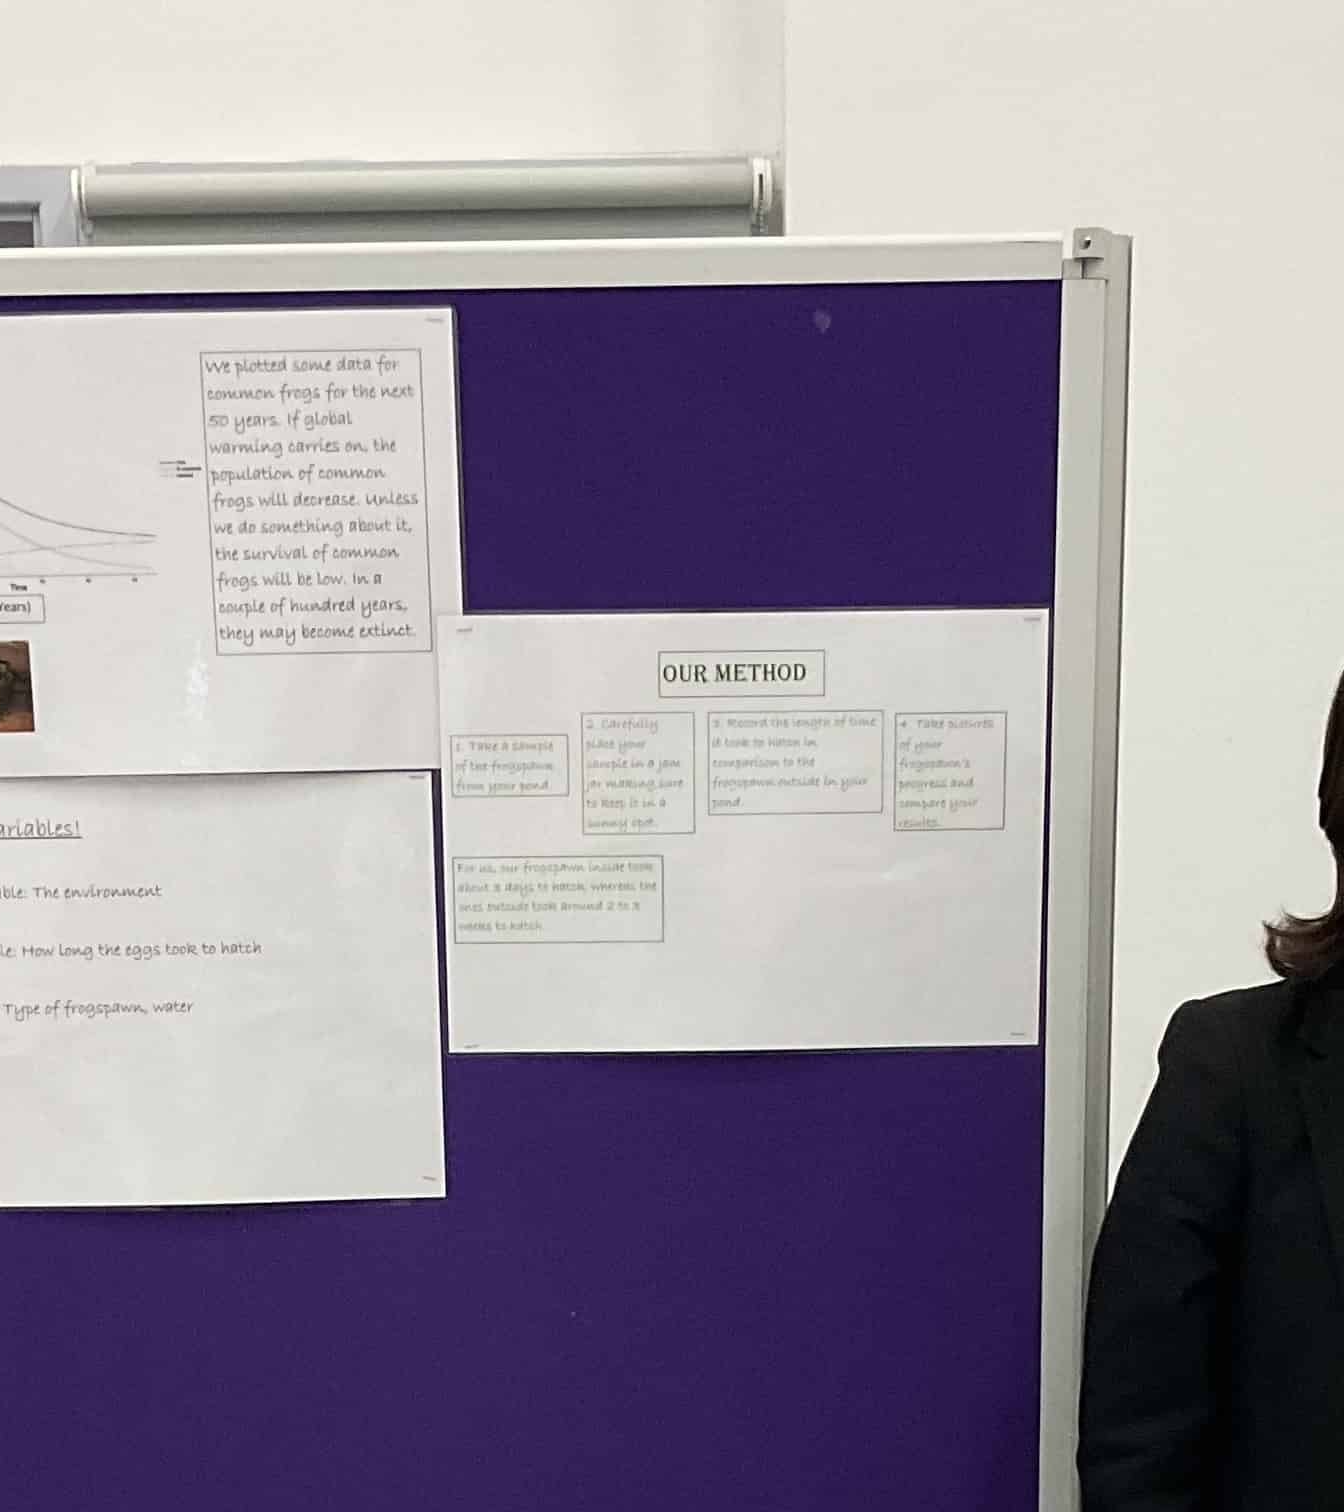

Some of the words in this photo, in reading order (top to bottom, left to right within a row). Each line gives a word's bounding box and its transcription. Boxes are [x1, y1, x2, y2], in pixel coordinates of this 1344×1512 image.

[204, 359, 231, 374] We
[233, 357, 287, 377] plotted
[292, 359, 332, 373] some
[335, 356, 372, 372] data
[375, 353, 400, 377] for
[205, 385, 275, 401] common
[279, 383, 321, 405] frogs
[324, 381, 348, 403] for
[351, 383, 377, 400] the
[380, 384, 415, 399] next
[207, 414, 230, 428] 50
[303, 410, 353, 432] global
[208, 439, 284, 459] warming
[287, 437, 341, 454] carries
[372, 436, 397, 453] the
[210, 465, 294, 486] population
[297, 463, 316, 484] of
[318, 468, 386, 480] common
[212, 491, 255, 513] frogs
[257, 491, 289, 507] will
[213, 522, 233, 535] we
[237, 519, 257, 535] do
[260, 518, 344, 538] something
[348, 517, 392, 533] about
[214, 546, 239, 562] the
[242, 544, 308, 561] survival
[311, 543, 330, 564] of
[332, 547, 400, 560] common
[215, 568, 259, 593] frogs
[261, 571, 293, 587] will
[296, 570, 313, 587] be
[373, 573, 382, 585] a
[218, 599, 265, 618] couple
[269, 596, 287, 617] of
[289, 596, 355, 613] hundred
[218, 624, 255, 647] they
[259, 627, 296, 646] may
[301, 623, 355, 639] become
[662, 663, 708, 684] OUR
[713, 662, 808, 684] METHOD
[31, 885, 60, 899] The
[63, 884, 162, 899] environment
[21, 944, 55, 958] How
[58, 943, 94, 961] long
[97, 943, 121, 957] the
[124, 944, 161, 961] eggs
[165, 942, 199, 956] took
[201, 943, 217, 955] to
[220, 940, 262, 955] hatch
[2, 1003, 41, 1020] Type
[44, 999, 61, 1017] of
[152, 1000, 194, 1013] water
